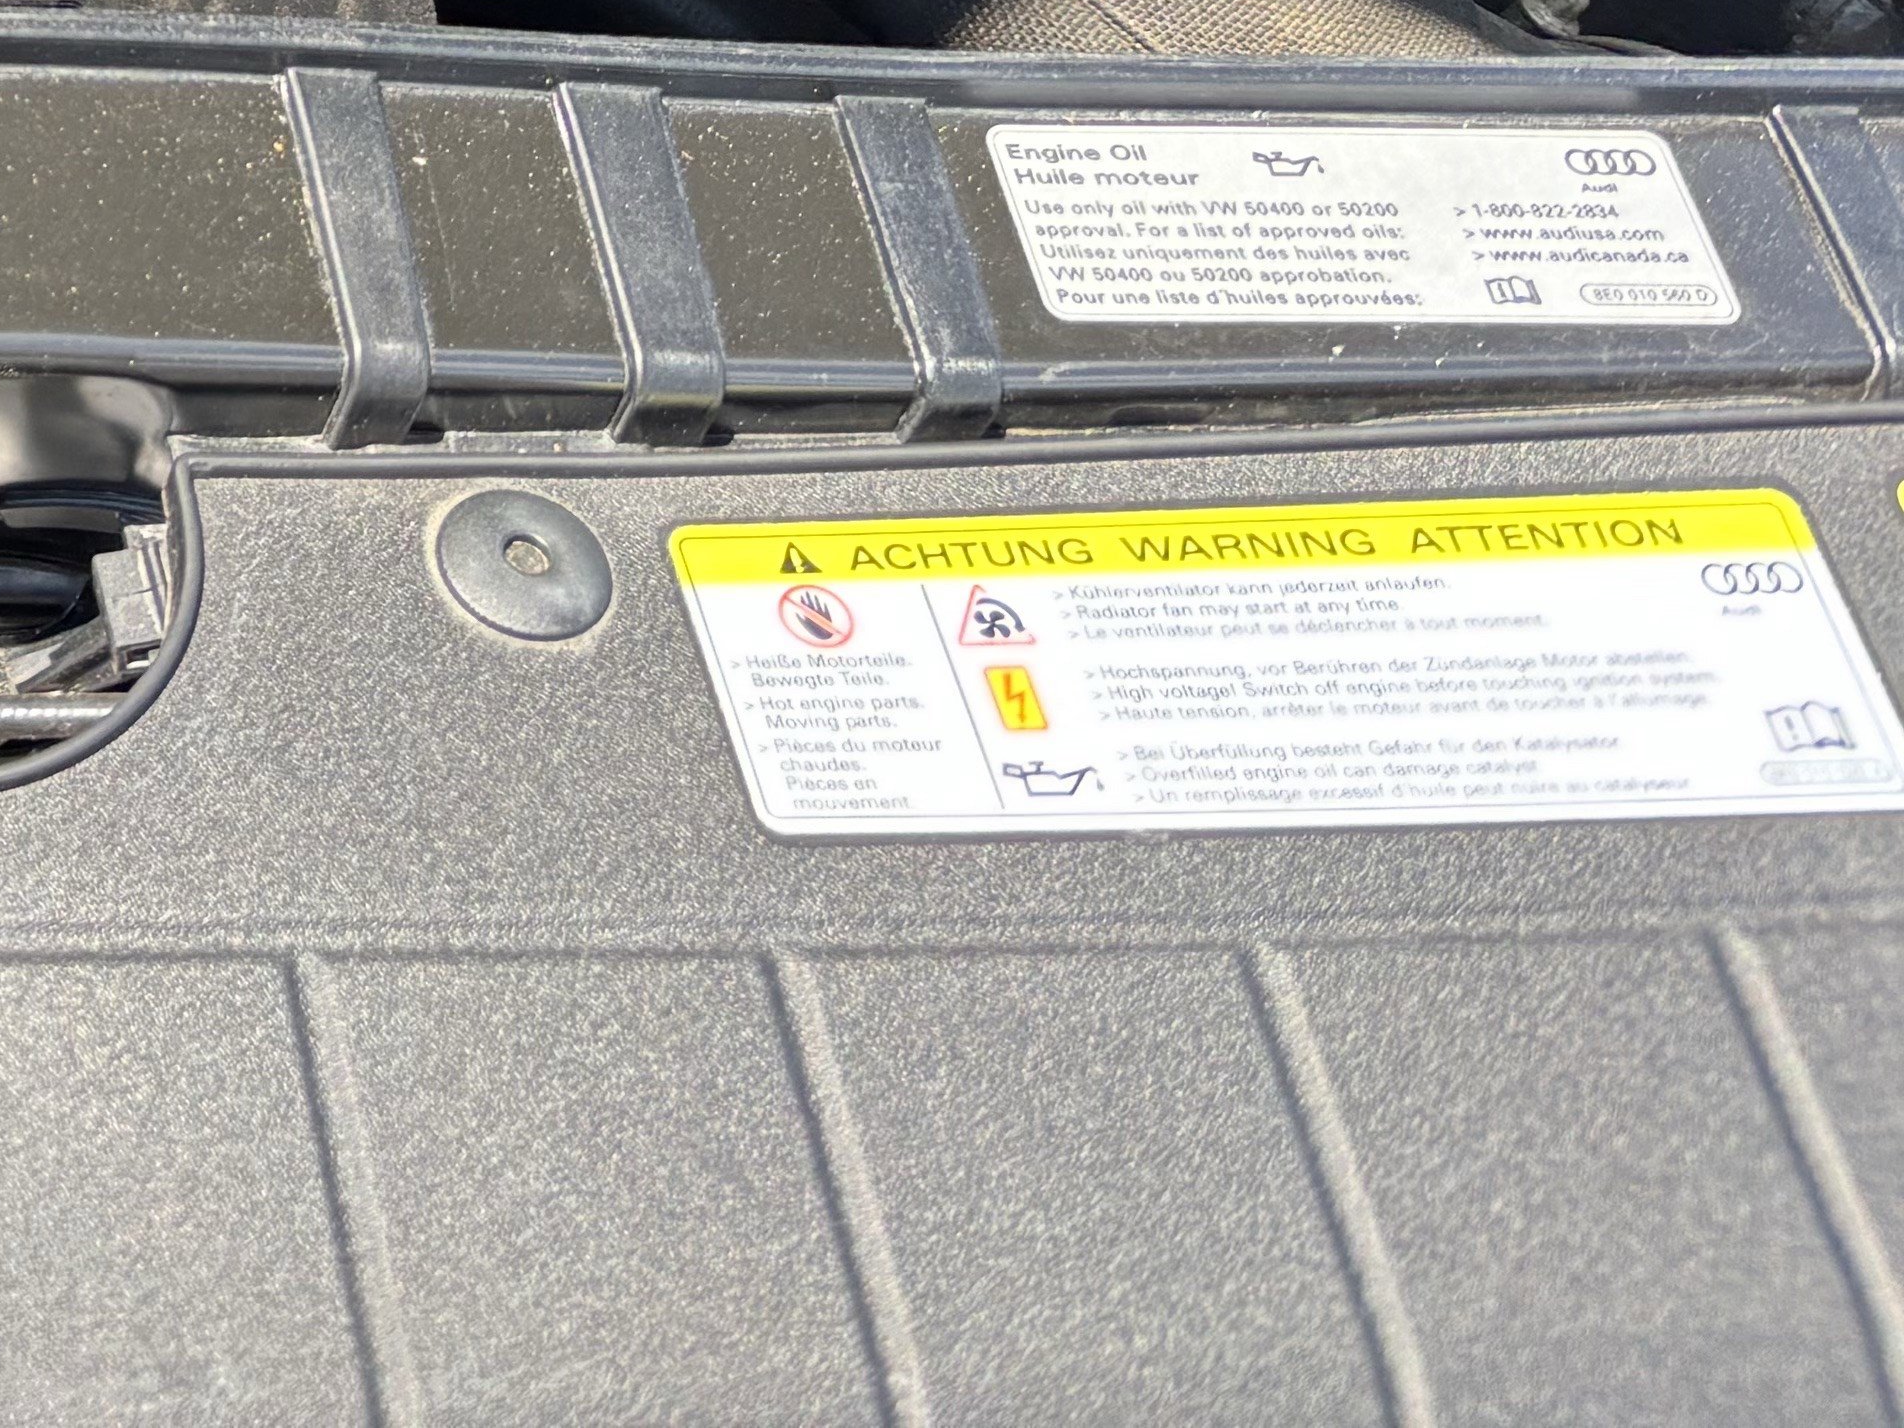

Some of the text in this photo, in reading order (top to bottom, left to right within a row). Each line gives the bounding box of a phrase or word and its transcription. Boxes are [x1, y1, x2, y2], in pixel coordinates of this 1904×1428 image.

[1005, 144, 1147, 163] Engine Oil
[1014, 168, 1199, 186] Huile moteur
[1582, 183, 1618, 193] Audi
[1024, 200, 1398, 218] Use only oil with VW 50400 or 50200
[1472, 203, 1619, 219] 1-800-822-2834
[1035, 222, 1405, 241] approval. For a list of approved oils:
[1479, 226, 1665, 242] www.audiusa.com
[1040, 244, 1410, 263] Utilisez uniquement des huiles avec
[1489, 248, 1689, 263] www.audicanada.ca
[1048, 266, 1392, 285] VW 50400 ou 50200 approbation.
[1056, 288, 1422, 308] Pour une liste d'huiles approuvées:
[851, 519, 1683, 571] ACHTUNG WARNING ATTENTION
[1069, 576, 1449, 599] Kühlerventilator kann jederzeit anlaufen.
[1076, 605, 1156, 619] Radiator
[1162, 603, 1193, 617] fan
[1199, 605, 1239, 618] may
[1245, 601, 1289, 616] start
[1295, 601, 1311, 614] at
[1318, 601, 1349, 615] any
[1084, 625, 1107, 639] Le
[1112, 623, 1213, 638] ventilateur
[1220, 622, 1262, 638] peut
[1268, 623, 1290, 636] se
[1295, 618, 1396, 634] déclencher
[1419, 617, 1459, 631] tout
[746, 652, 912, 669] Heiße Motorteile.
[1100, 664, 1251, 681] Hochspannung,
[1257, 664, 1287, 676] vor
[1292, 659, 1382, 675] Berühren
[1388, 658, 1417, 673] der
[1423, 655, 1537, 673] Zündanlage
[1541, 653, 1598, 668] Motor
[751, 671, 889, 690] Bewegte Teile.
[1107, 685, 1153, 703] High
[1242, 681, 1308, 697] Switch
[1315, 680, 1338, 695] off
[1346, 679, 1411, 698] engine
[1414, 677, 1478, 693] before
[1482, 675, 1568, 693] touching
[759, 696, 924, 713] Hot engine parts.
[1115, 706, 1173, 721] Haute
[1177, 707, 1255, 720] tension,
[1262, 702, 1324, 718] arrêter
[1329, 701, 1348, 717] le
[1353, 702, 1421, 715] moteur
[1428, 699, 1480, 714] avant
[1486, 697, 1510, 712] de
[1514, 695, 1586, 712] toucher
[765, 714, 897, 732] Moving parts.
[774, 738, 941, 754] Pièces du moteur
[1133, 745, 1164, 761] Bei
[1169, 743, 1287, 762] Überfüllung
[1291, 742, 1362, 758] besteht
[1368, 740, 1432, 756] Gefahr
[1472, 738, 1507, 754] den
[780, 757, 866, 772] chaudes.
[1141, 765, 1237, 782] Overfilled
[1243, 764, 1308, 783] engine
[1314, 763, 1337, 779] oil
[1343, 765, 1376, 778] can
[1383, 762, 1460, 779] damage
[785, 775, 878, 791] Pièces en
[1149, 788, 1179, 804] Un
[1185, 787, 1302, 805] remplissage
[1309, 783, 1384, 801] excessif
